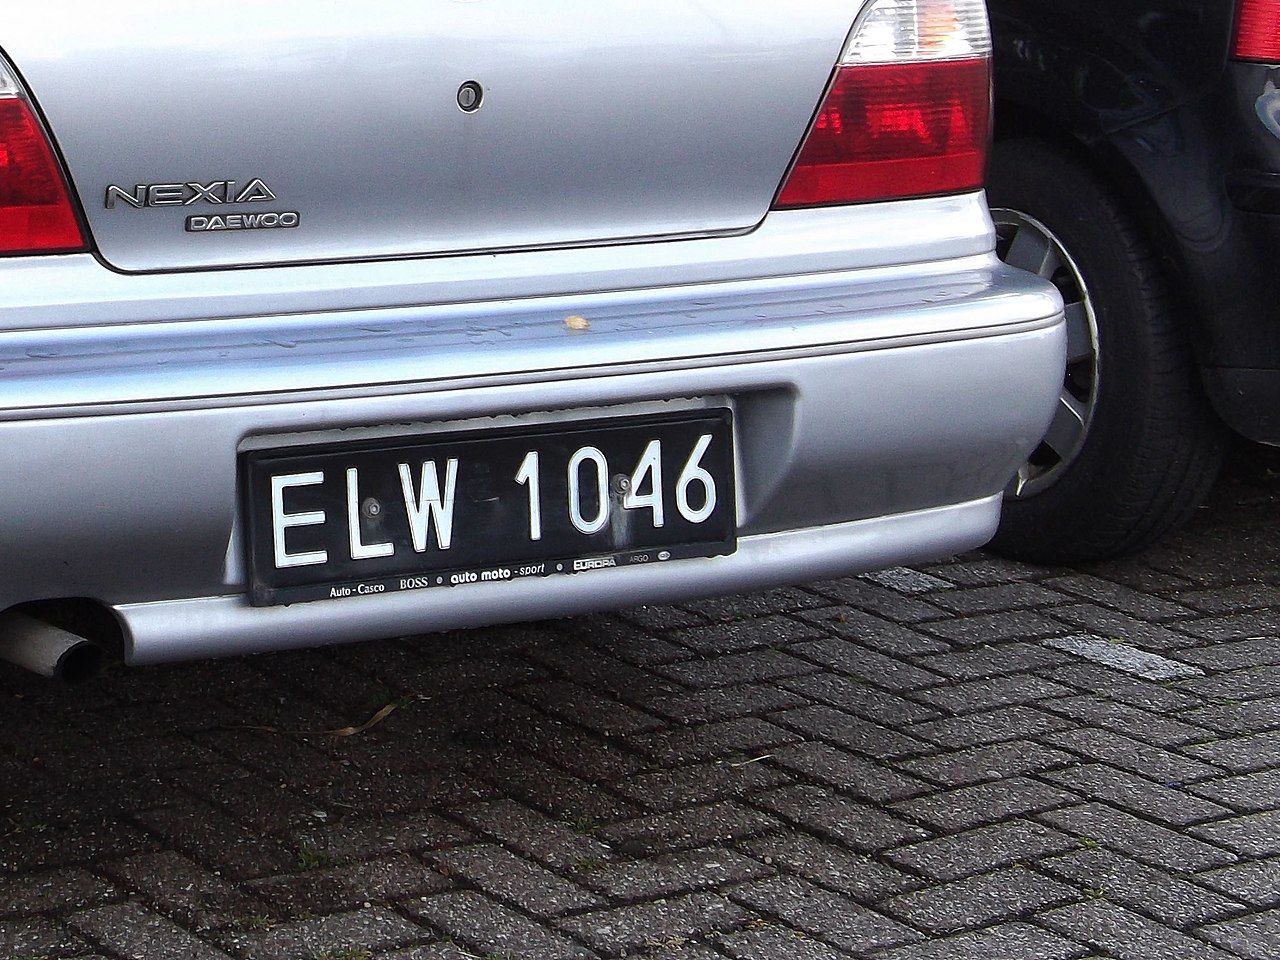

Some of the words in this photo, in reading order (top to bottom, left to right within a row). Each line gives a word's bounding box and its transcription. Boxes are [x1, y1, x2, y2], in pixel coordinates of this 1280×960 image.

[105, 178, 276, 209] NEXIA
[189, 212, 298, 231] DAEWOO
[270, 458, 459, 569] ELW
[514, 434, 716, 541] 1046
[399, 576, 429, 590] BOSS
[450, 571, 478, 585] auto
[573, 556, 617, 571] EUROPA
